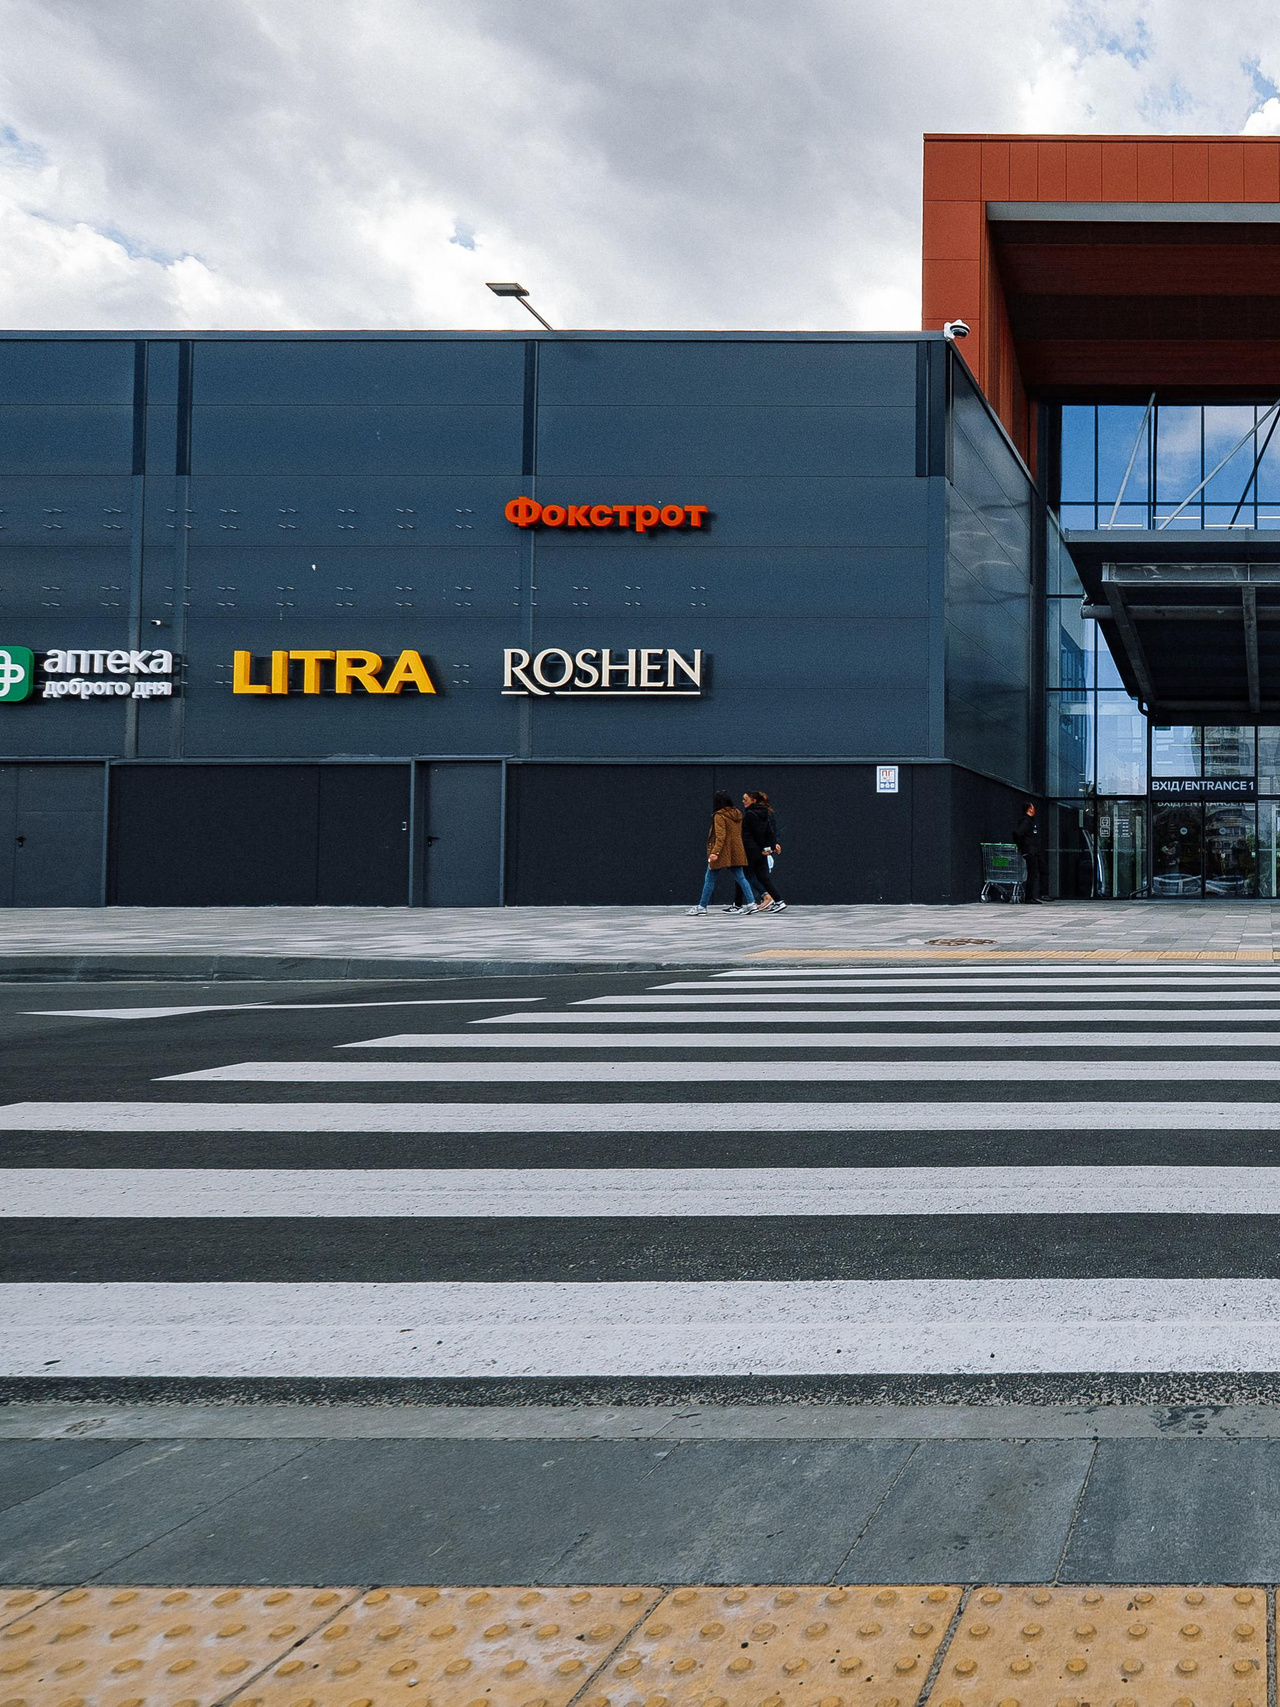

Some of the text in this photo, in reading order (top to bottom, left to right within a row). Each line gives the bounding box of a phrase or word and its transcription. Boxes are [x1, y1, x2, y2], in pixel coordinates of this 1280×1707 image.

[505, 495, 709, 533] Фокстрот
[43, 649, 173, 674] аптека
[232, 649, 437, 695] LITRA
[502, 648, 702, 695] ROSHEN
[43, 678, 172, 699] доброго дня
[1152, 781, 1254, 792] ВХІД/ENTRANCE 1
